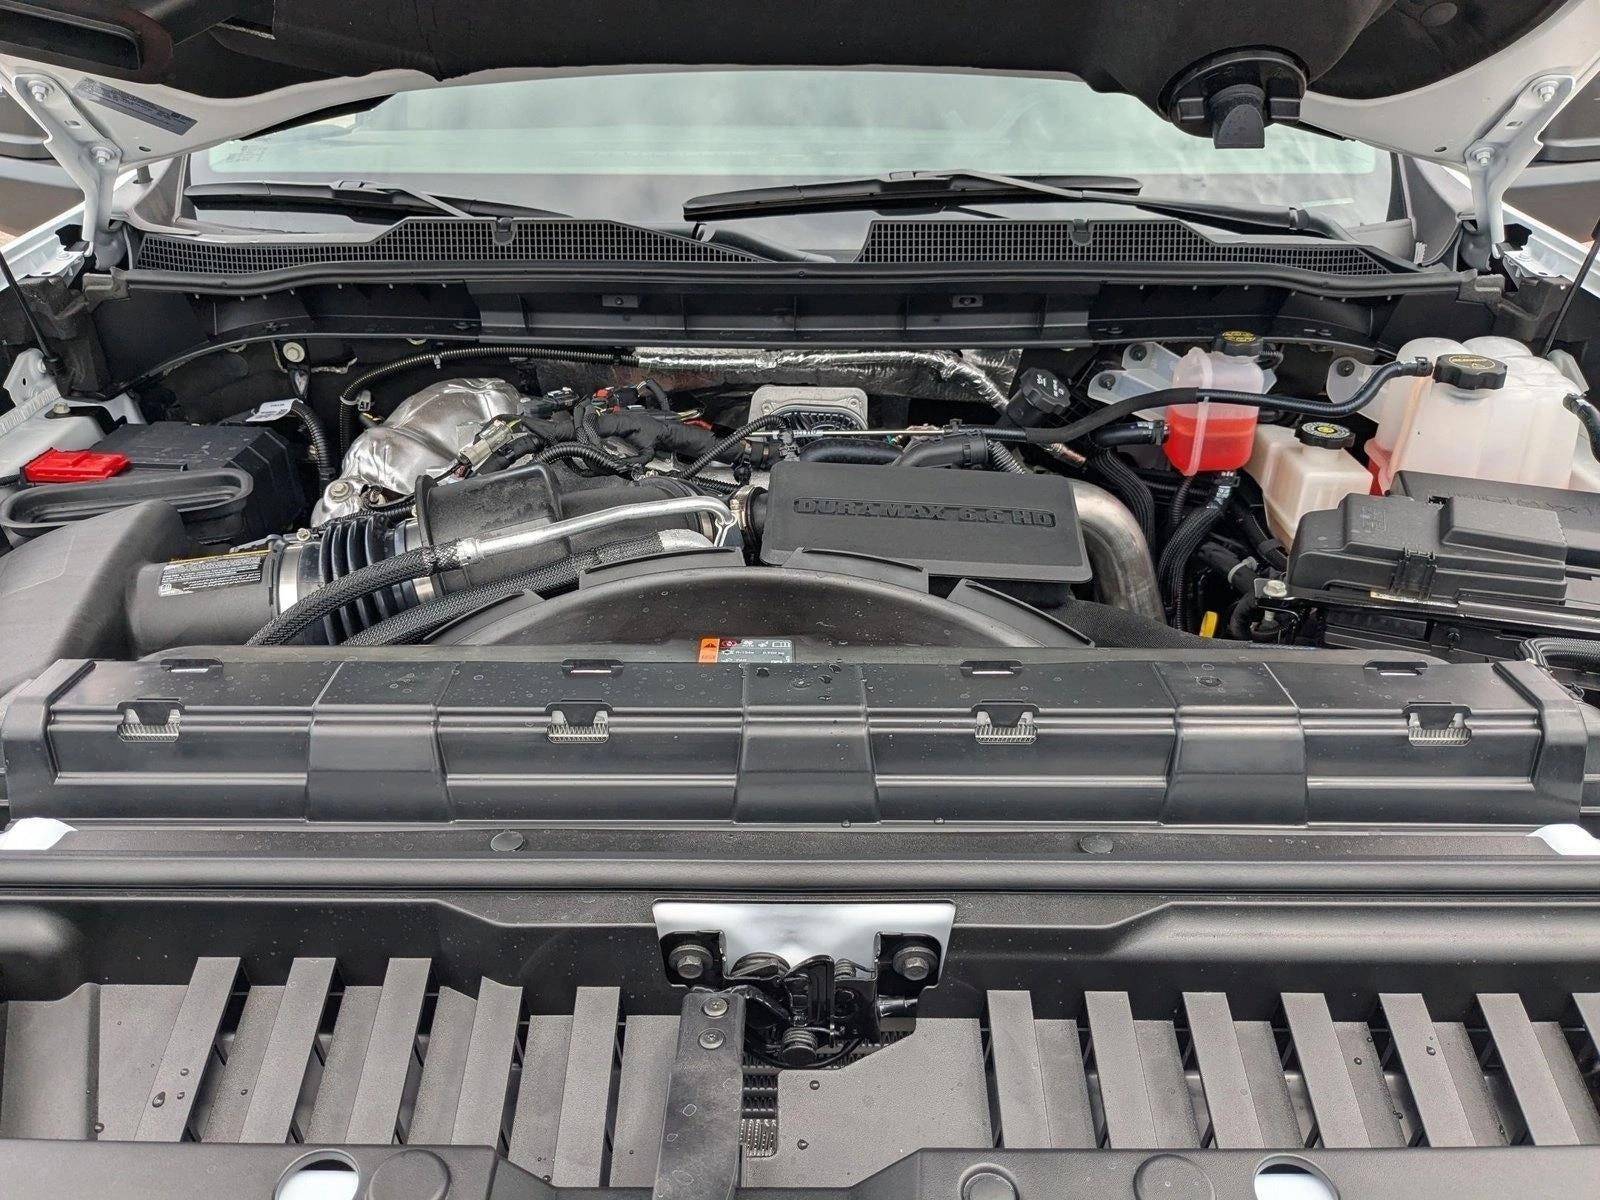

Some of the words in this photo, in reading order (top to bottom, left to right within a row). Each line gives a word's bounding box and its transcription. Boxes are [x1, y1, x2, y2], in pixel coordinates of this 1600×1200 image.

[796, 499, 946, 520] DURAMAX
[959, 506, 1004, 522] 6.6
[1012, 509, 1055, 527] HD
